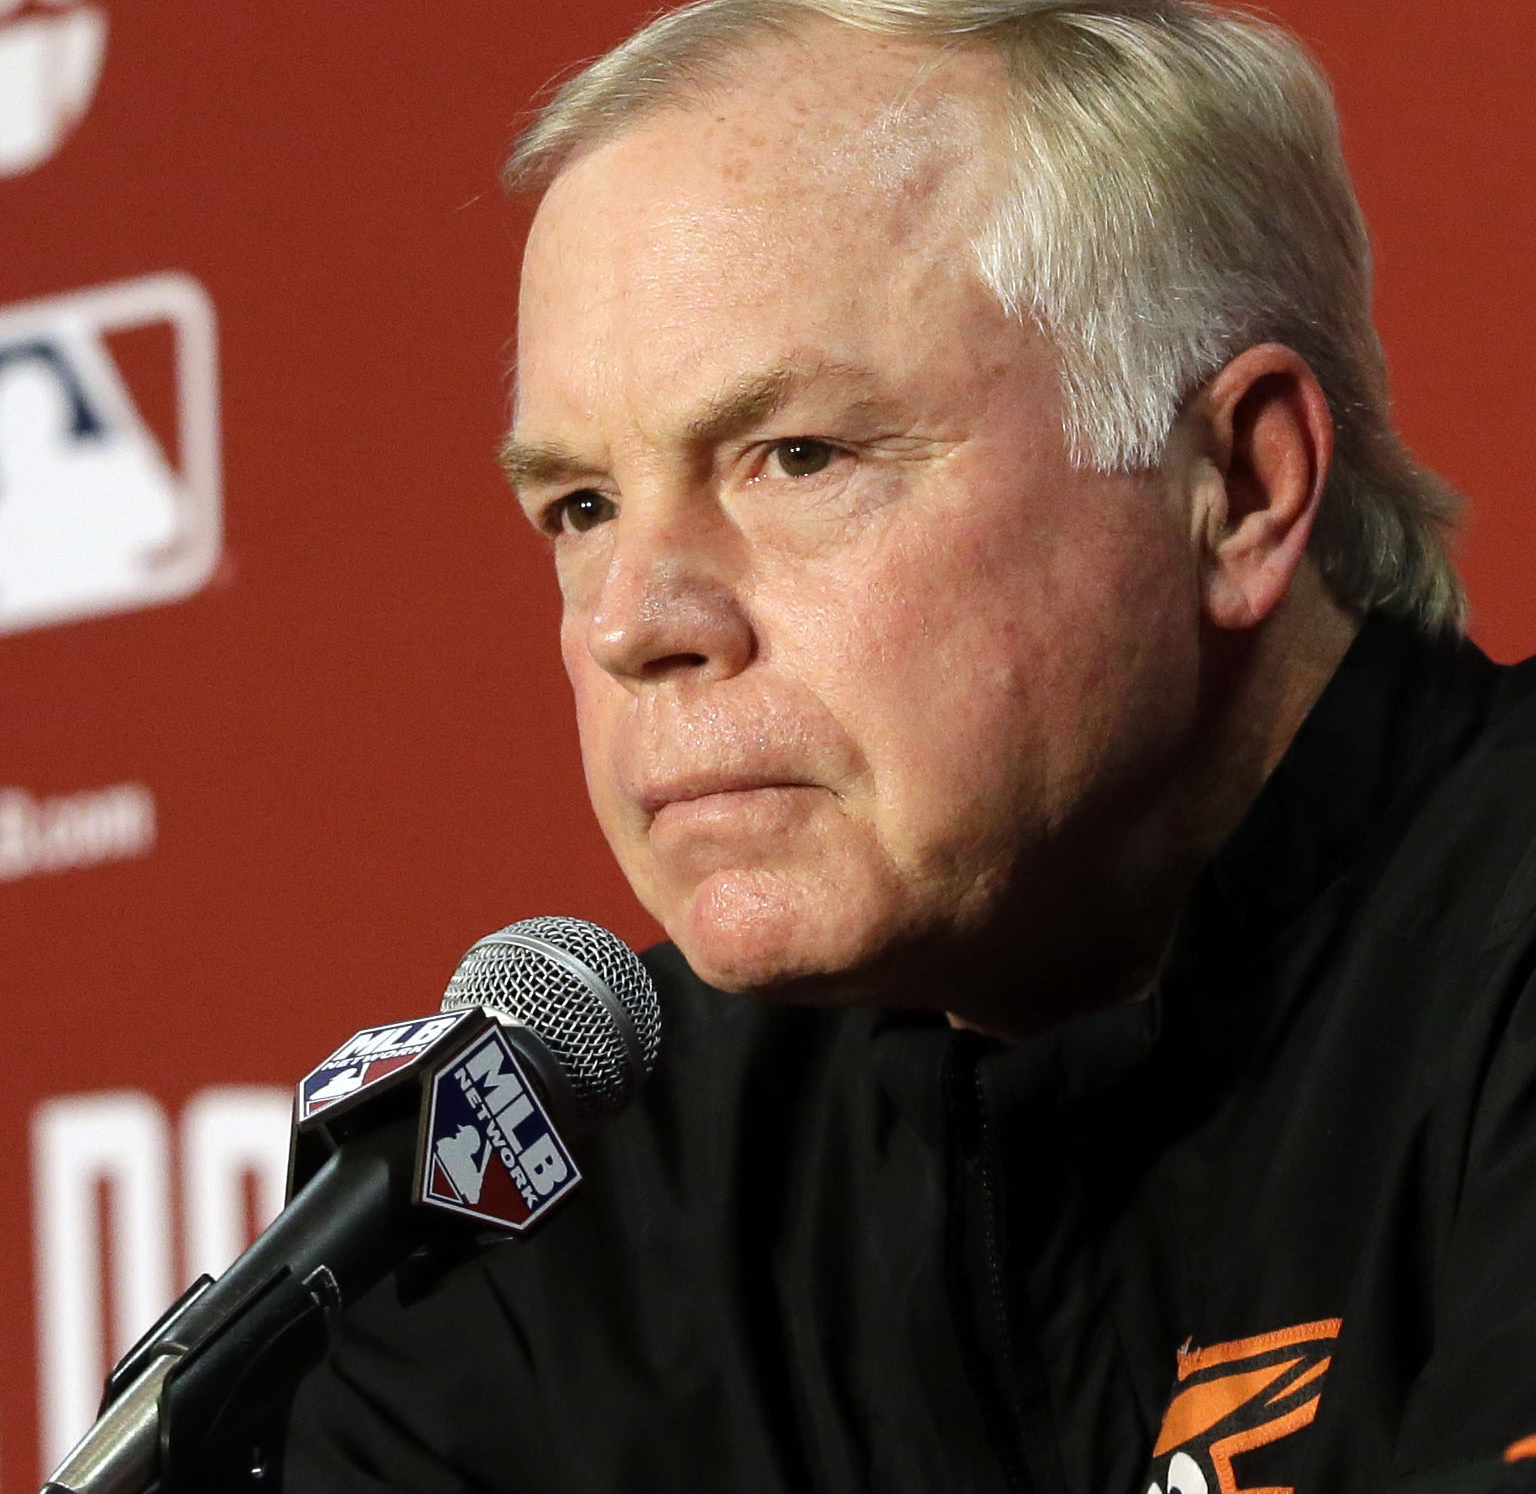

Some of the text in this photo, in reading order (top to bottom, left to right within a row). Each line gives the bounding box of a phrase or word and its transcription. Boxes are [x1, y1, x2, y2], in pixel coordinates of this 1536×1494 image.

[321, 1043, 428, 1071] NETWORK
[340, 1017, 458, 1058] MLB
[454, 1067, 539, 1209] NETWORK
[465, 1040, 567, 1196] MLB
